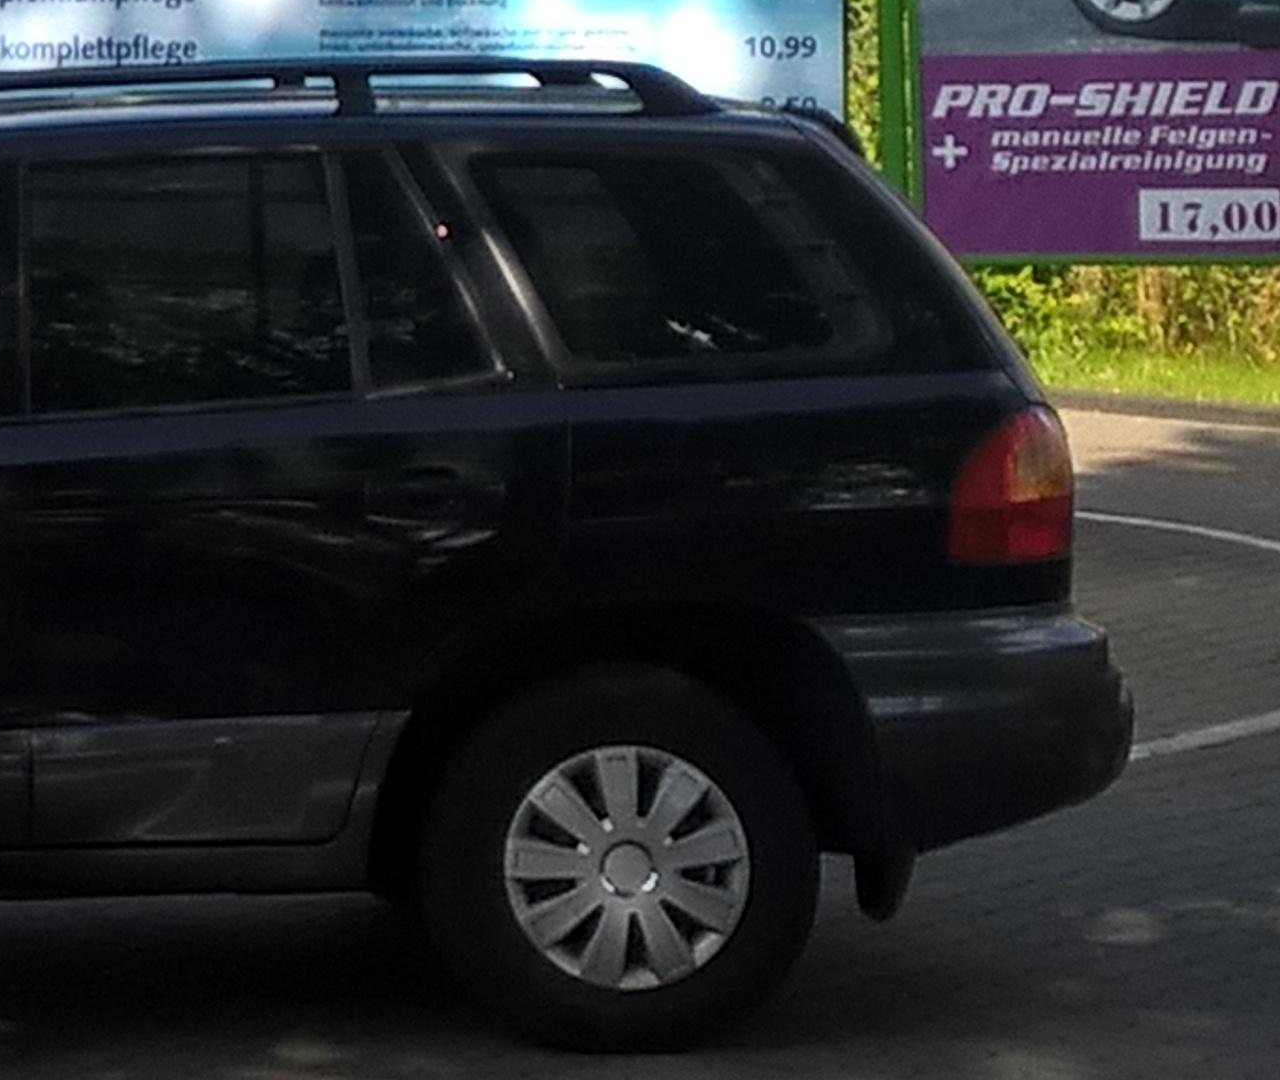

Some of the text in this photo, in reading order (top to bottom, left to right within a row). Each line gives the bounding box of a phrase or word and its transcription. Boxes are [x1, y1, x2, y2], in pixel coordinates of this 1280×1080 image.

[0, 34, 197, 67] komplettpflege
[745, 36, 817, 60] 10,99
[932, 80, 1279, 118] PRO-SHIELD
[991, 124, 1273, 149] manuelle Felgen-
[991, 150, 1268, 175] Spezialreinigung
[1156, 201, 1279, 237] 17,00
